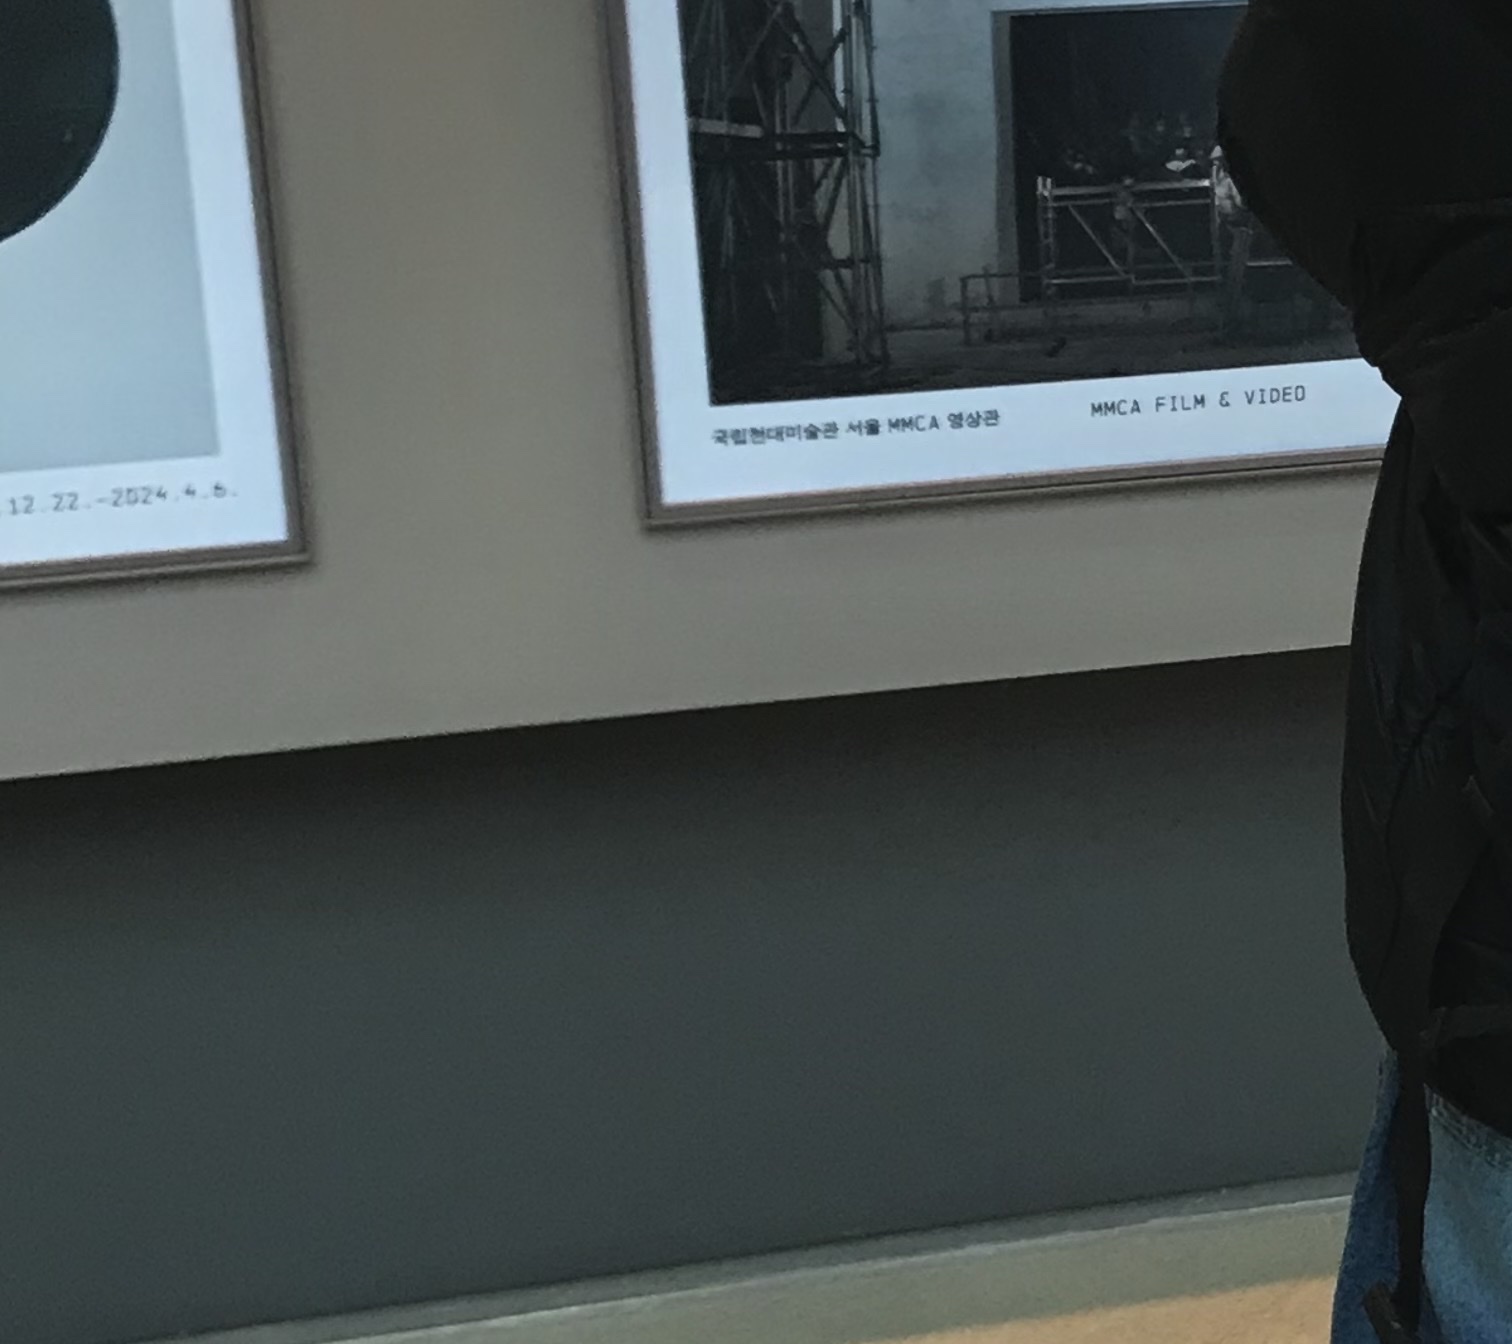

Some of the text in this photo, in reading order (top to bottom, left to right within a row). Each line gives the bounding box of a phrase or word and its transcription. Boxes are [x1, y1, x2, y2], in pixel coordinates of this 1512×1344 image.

[1091, 385, 1305, 416] MMCA FILM & VIDEO
[848, 419, 880, 435] 서울
[888, 415, 939, 432] MMCA
[947, 409, 1000, 429] 영상관
